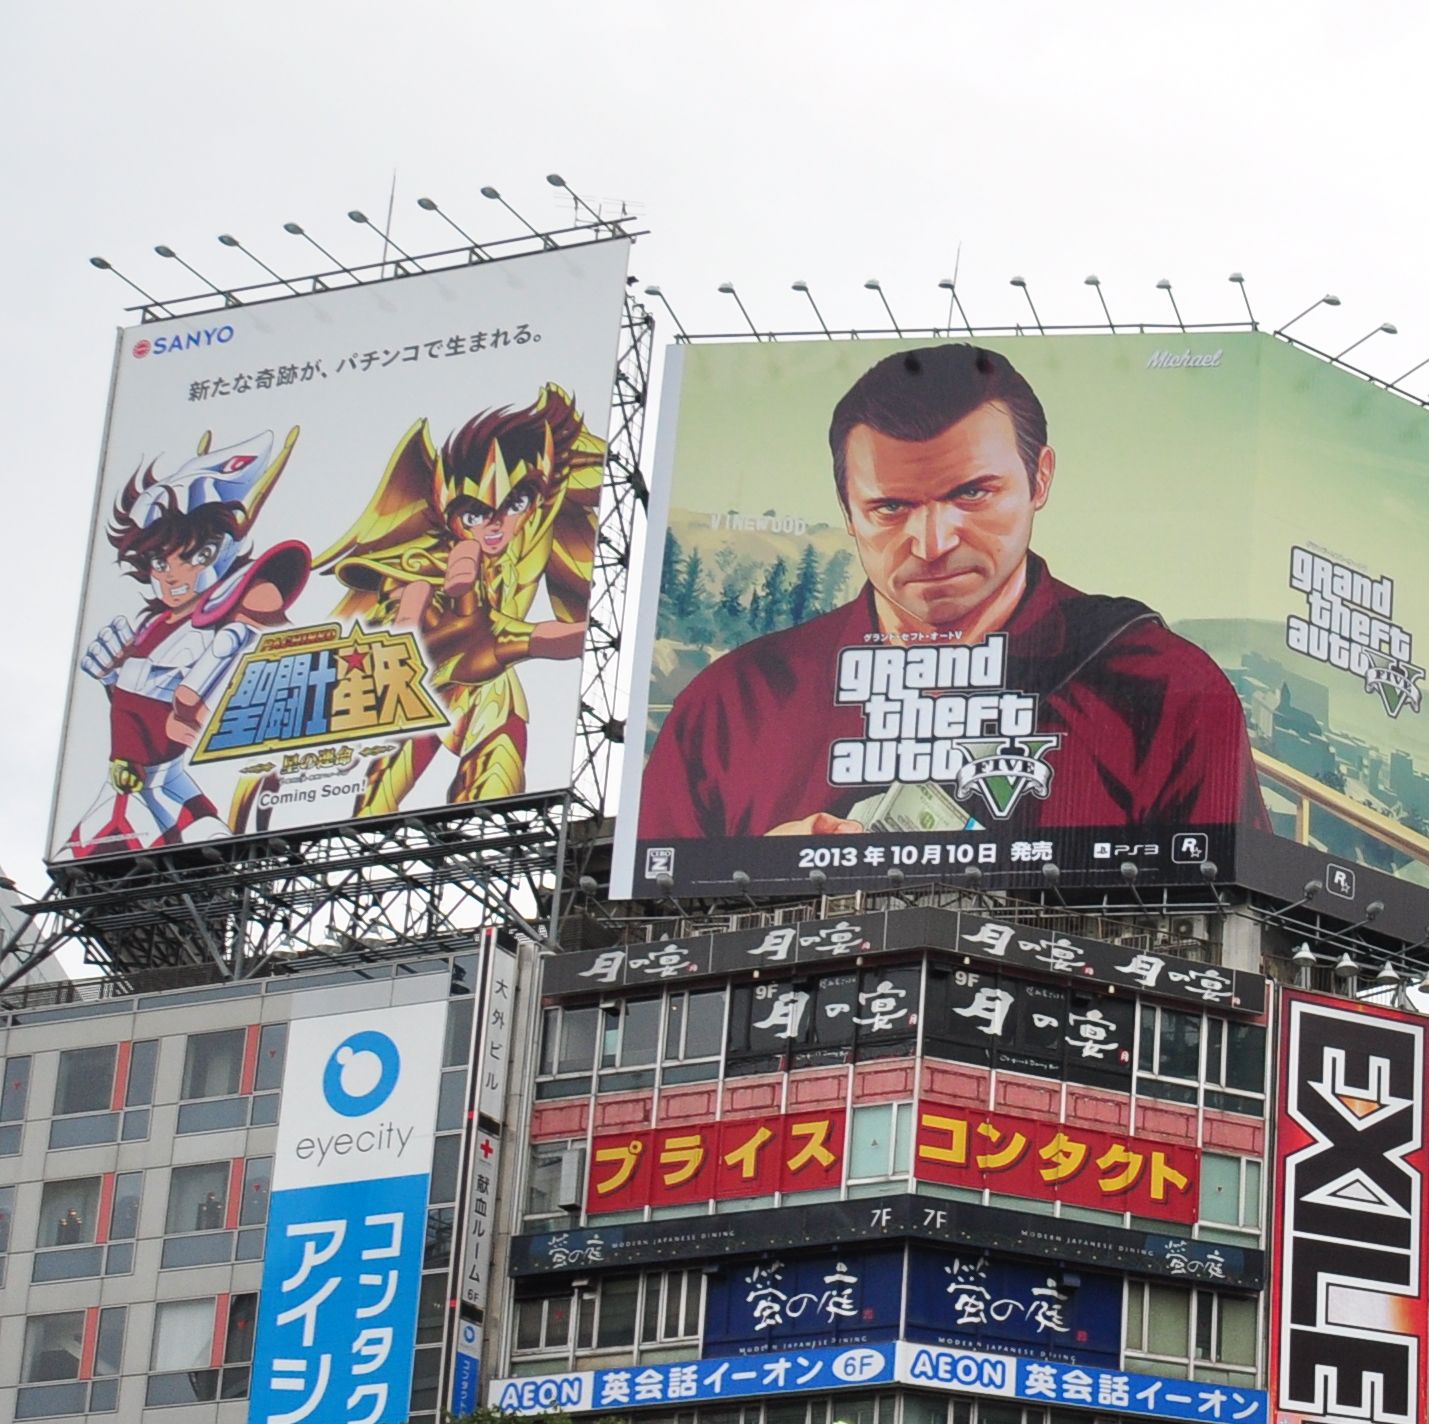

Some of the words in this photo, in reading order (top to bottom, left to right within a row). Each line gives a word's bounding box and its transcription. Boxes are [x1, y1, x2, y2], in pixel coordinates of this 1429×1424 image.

[153, 325, 235, 355] SANYO
[1146, 347, 1224, 370] Michael
[188, 323, 543, 402] 新たな奇跡が、パチンコで生まれる。
[710, 511, 808, 537] VINEWOOD
[1374, 669, 1414, 693] FIVE
[865, 693, 1037, 740] theft
[830, 738, 962, 785] auto
[973, 757, 1036, 777] FIVE
[259, 790, 317, 808] Coming
[320, 779, 367, 798] Soon!
[1011, 840, 1053, 862] 発売
[1114, 842, 1160, 857] PS3
[750, 921, 864, 960] 月の宴
[962, 922, 1086, 975] 月の宴
[579, 944, 690, 983] 月の宴
[954, 970, 979, 987] 9F
[1114, 951, 1234, 1002] 月の宴
[752, 981, 909, 1039] 月の宴
[755, 984, 778, 999] 9F
[484, 976, 507, 1091] 大外ビル
[952, 987, 1119, 1059] 月の宴
[296, 1120, 415, 1167] eyecity
[595, 1117, 837, 1195] プライス
[918, 1113, 1190, 1201] コンタクト
[468, 1173, 491, 1284] 献血ルーム
[869, 1205, 893, 1229] 7F
[923, 1207, 948, 1231] 7F
[611, 1240, 651, 1250] MODERN
[655, 1236, 701, 1247] JAPANESE
[702, 1230, 736, 1241] DINING
[1020, 1230, 1064, 1243] MODERN
[1066, 1237, 1115, 1251] JAPANESE
[1117, 1246, 1154, 1258] DINING
[938, 1336, 983, 1349] MODERN
[986, 1343, 1037, 1356] JAPANESE
[600, 1355, 824, 1400] 英会話イーオン
[843, 1356, 875, 1377] 6F
[910, 1349, 1006, 1389] AEON
[502, 1376, 583, 1413] AEON
[1023, 1363, 1262, 1421] 英会話イーオン
